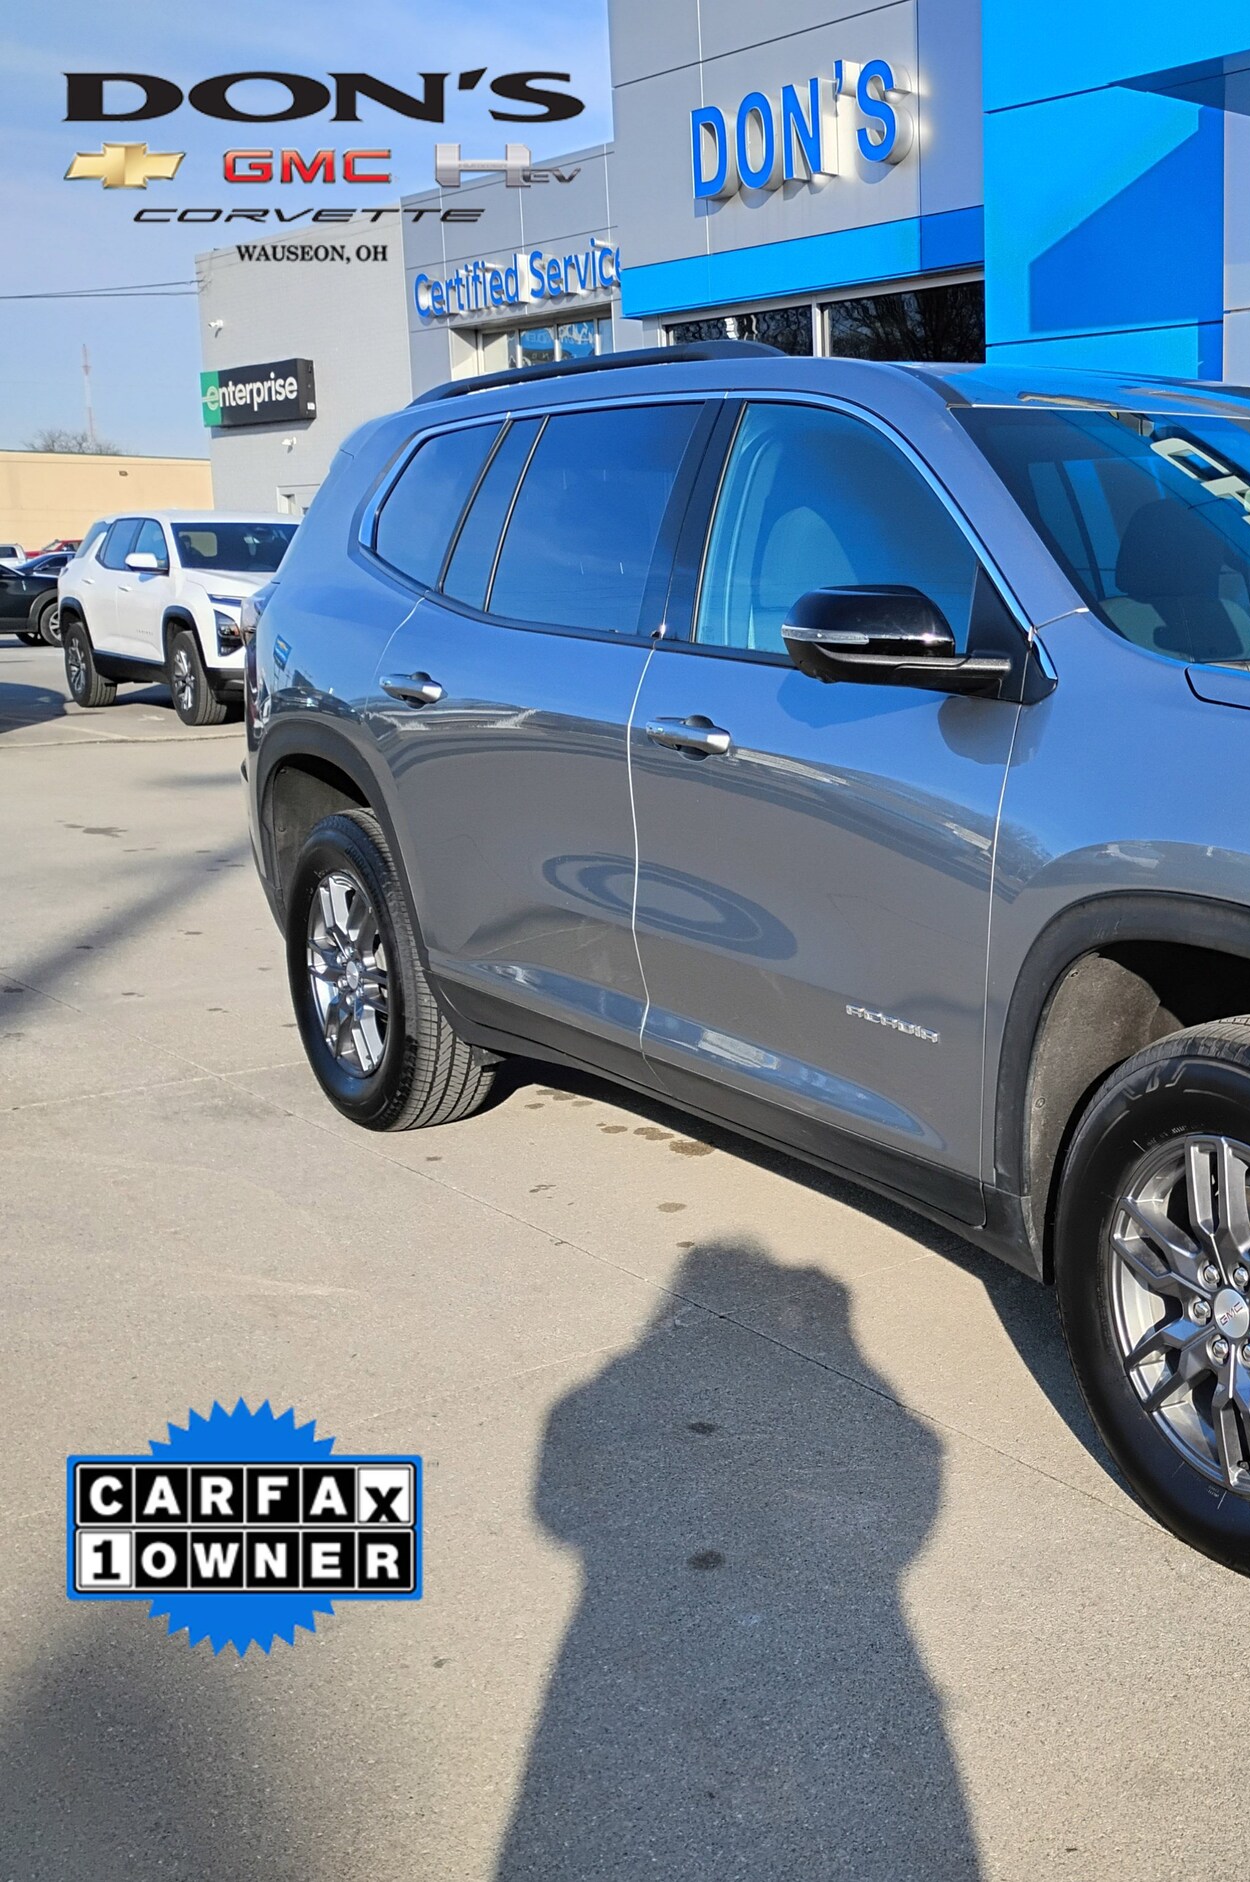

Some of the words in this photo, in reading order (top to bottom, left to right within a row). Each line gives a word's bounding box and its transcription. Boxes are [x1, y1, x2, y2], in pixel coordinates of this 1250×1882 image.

[690, 58, 900, 200] DON'S
[414, 253, 520, 318] Certified
[206, 371, 298, 412] enterprise
[1219, 1301, 1243, 1326] GMC
